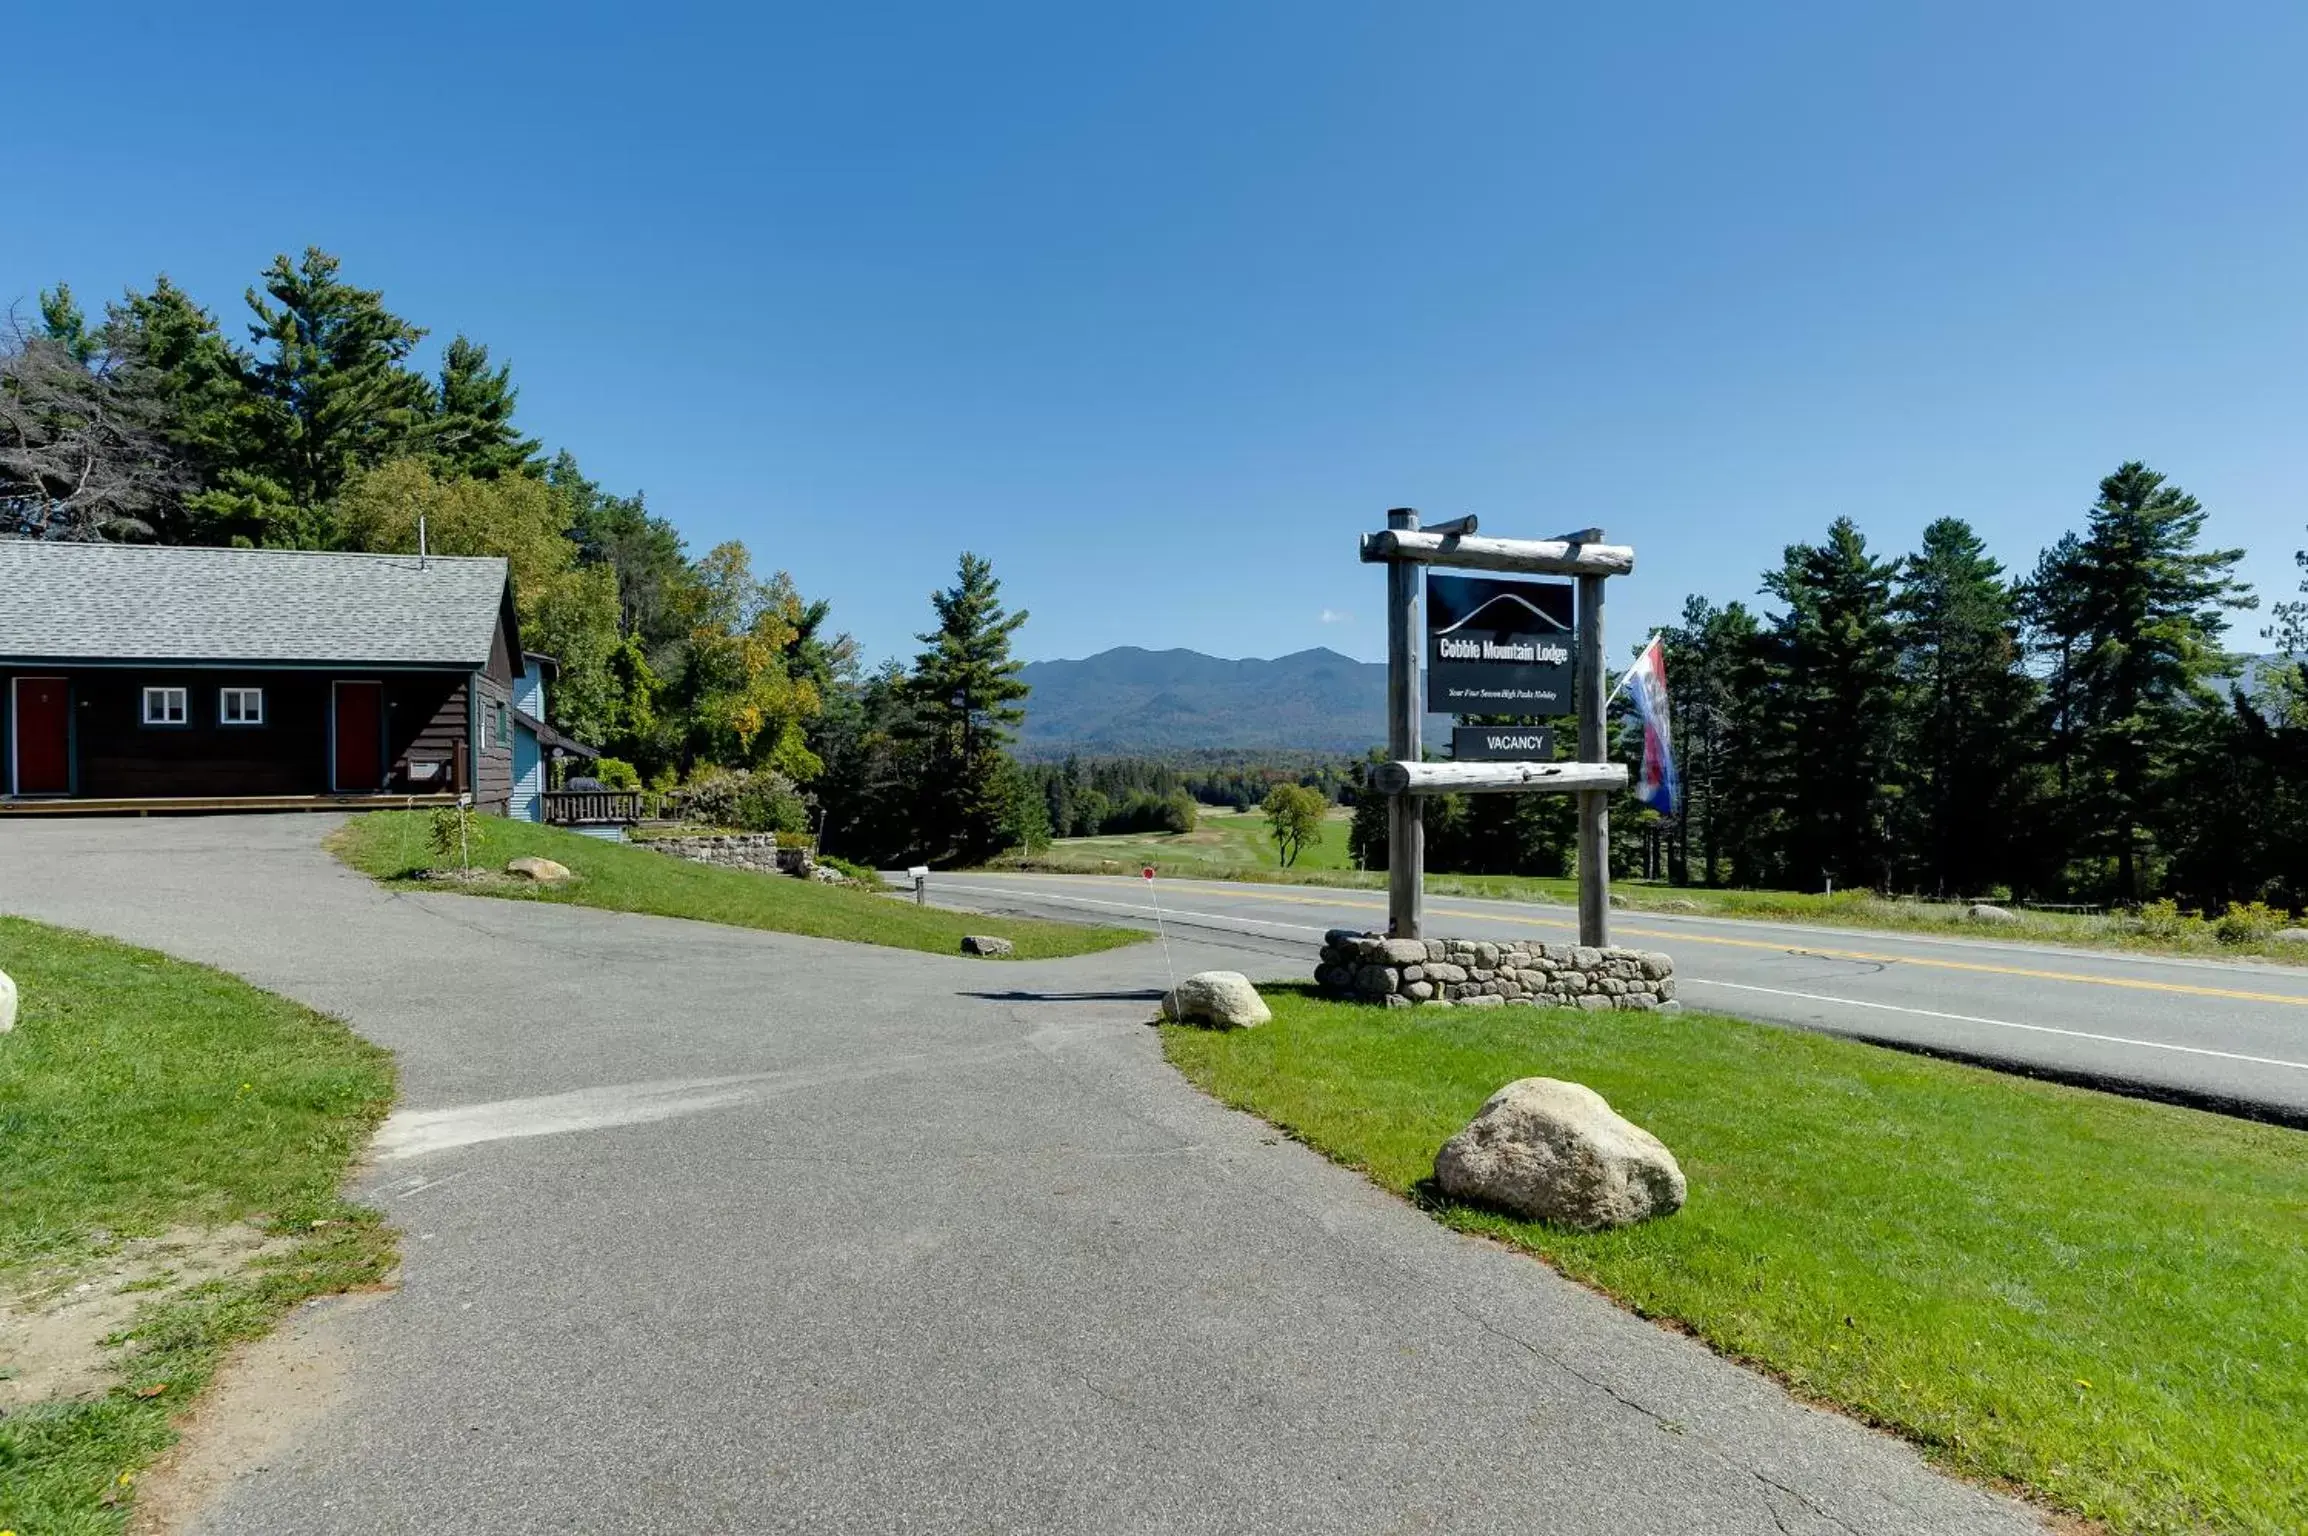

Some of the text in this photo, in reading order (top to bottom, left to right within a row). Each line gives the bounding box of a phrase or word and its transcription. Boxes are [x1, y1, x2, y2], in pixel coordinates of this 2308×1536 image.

[1440, 638, 1568, 665] Cobble Mountain Lodge
[1487, 736, 1543, 750] VACANCY
